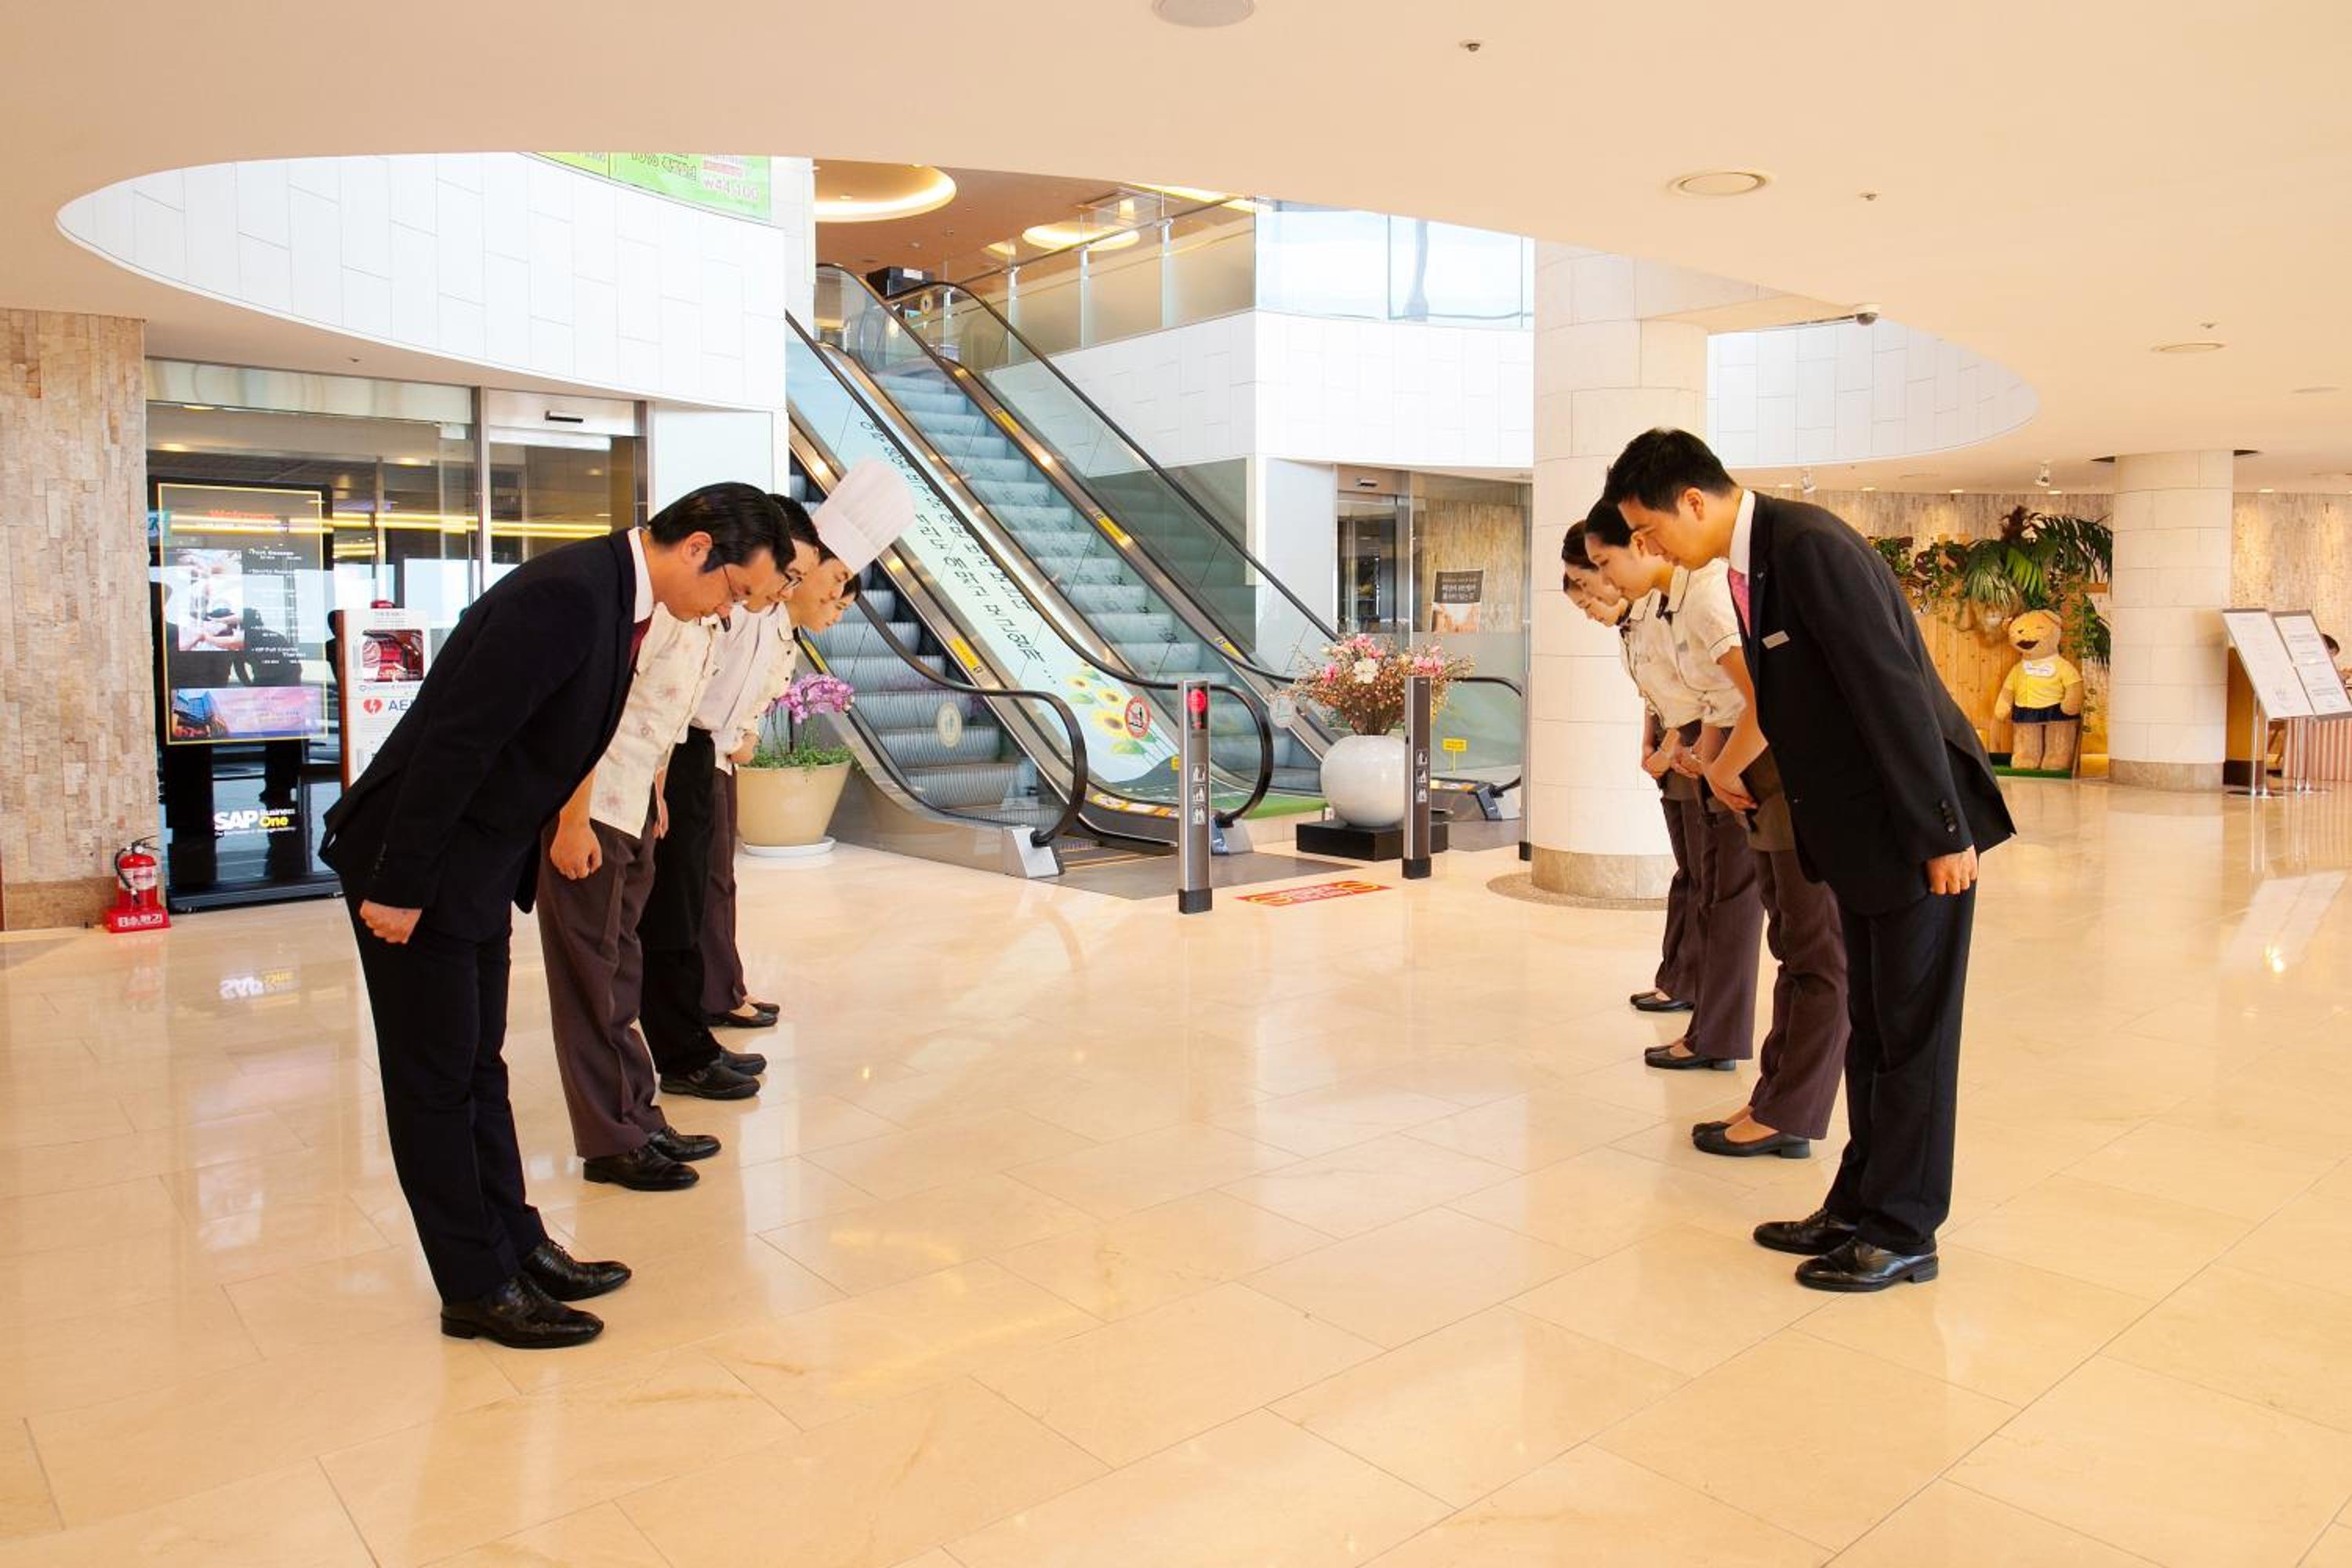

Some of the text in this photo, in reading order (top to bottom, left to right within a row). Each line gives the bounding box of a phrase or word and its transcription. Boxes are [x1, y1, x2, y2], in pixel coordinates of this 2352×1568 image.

[388, 699, 416, 711] AE
[214, 810, 259, 830] SAP
[260, 816, 289, 828] One
